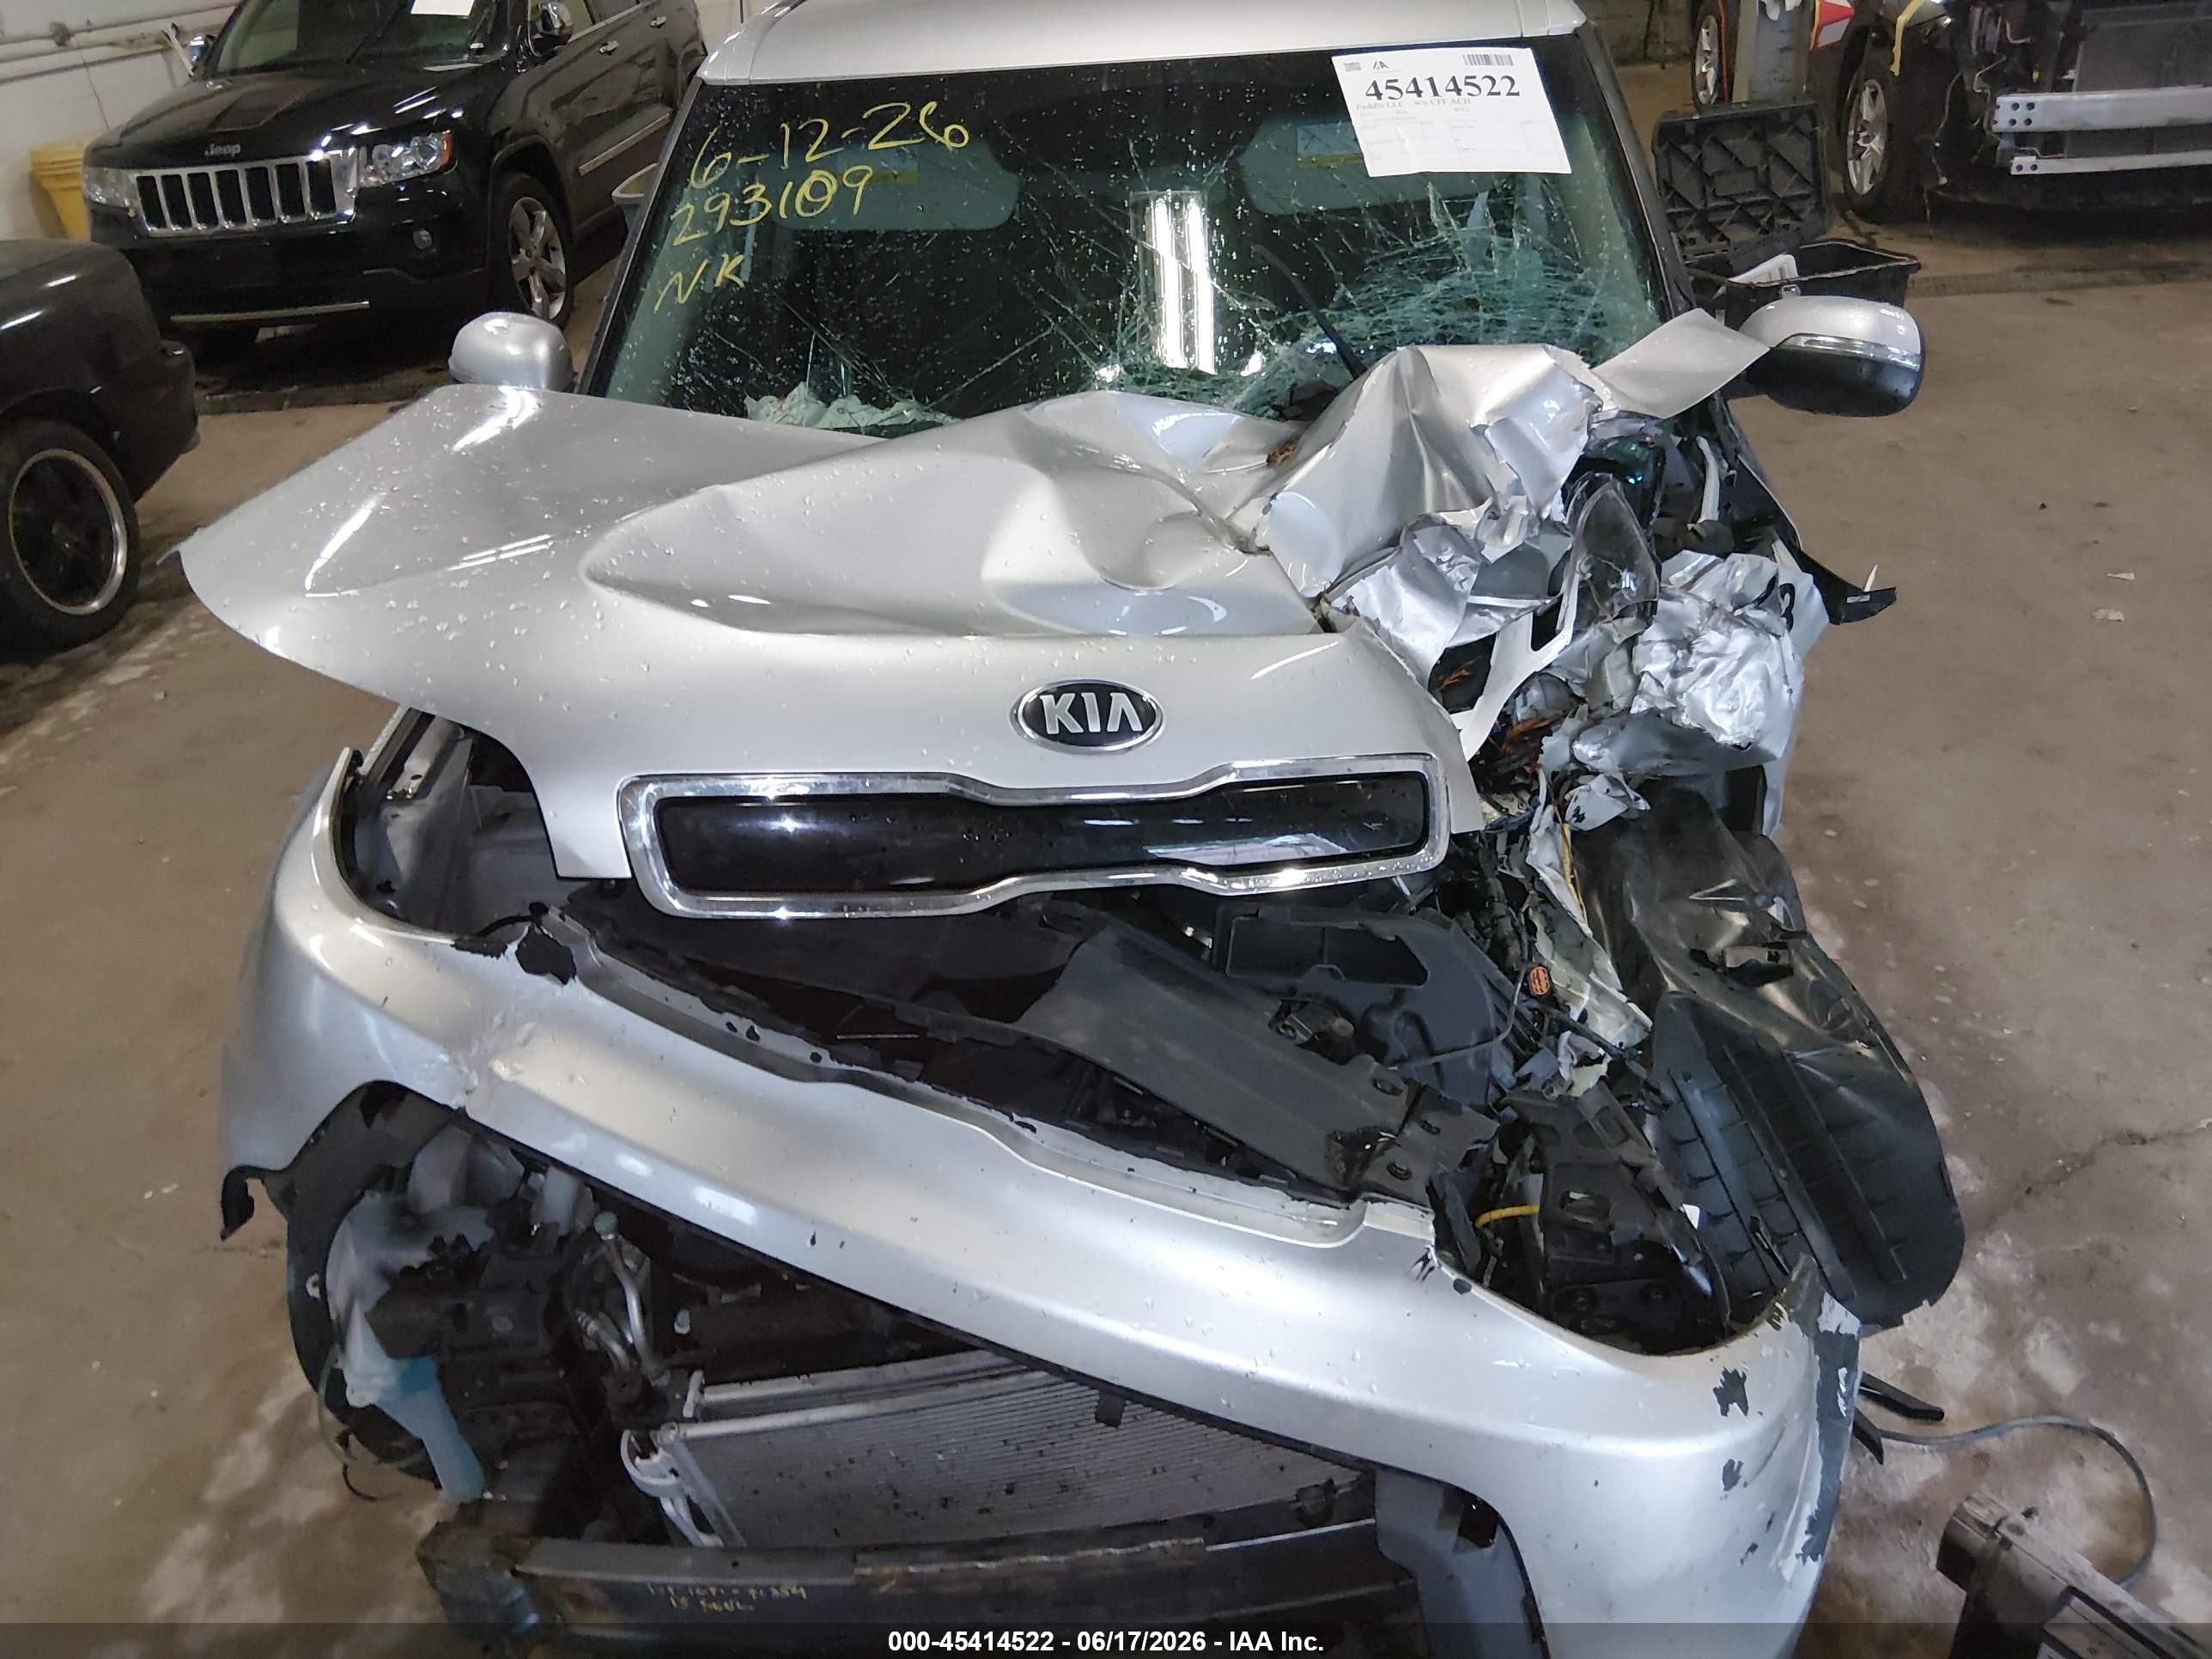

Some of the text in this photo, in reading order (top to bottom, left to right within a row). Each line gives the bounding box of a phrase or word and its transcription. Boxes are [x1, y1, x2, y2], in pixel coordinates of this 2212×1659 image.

[1365, 75, 1520, 100] 45414522
[204, 143, 241, 158] Jeep
[1040, 692, 1143, 735] KIA
